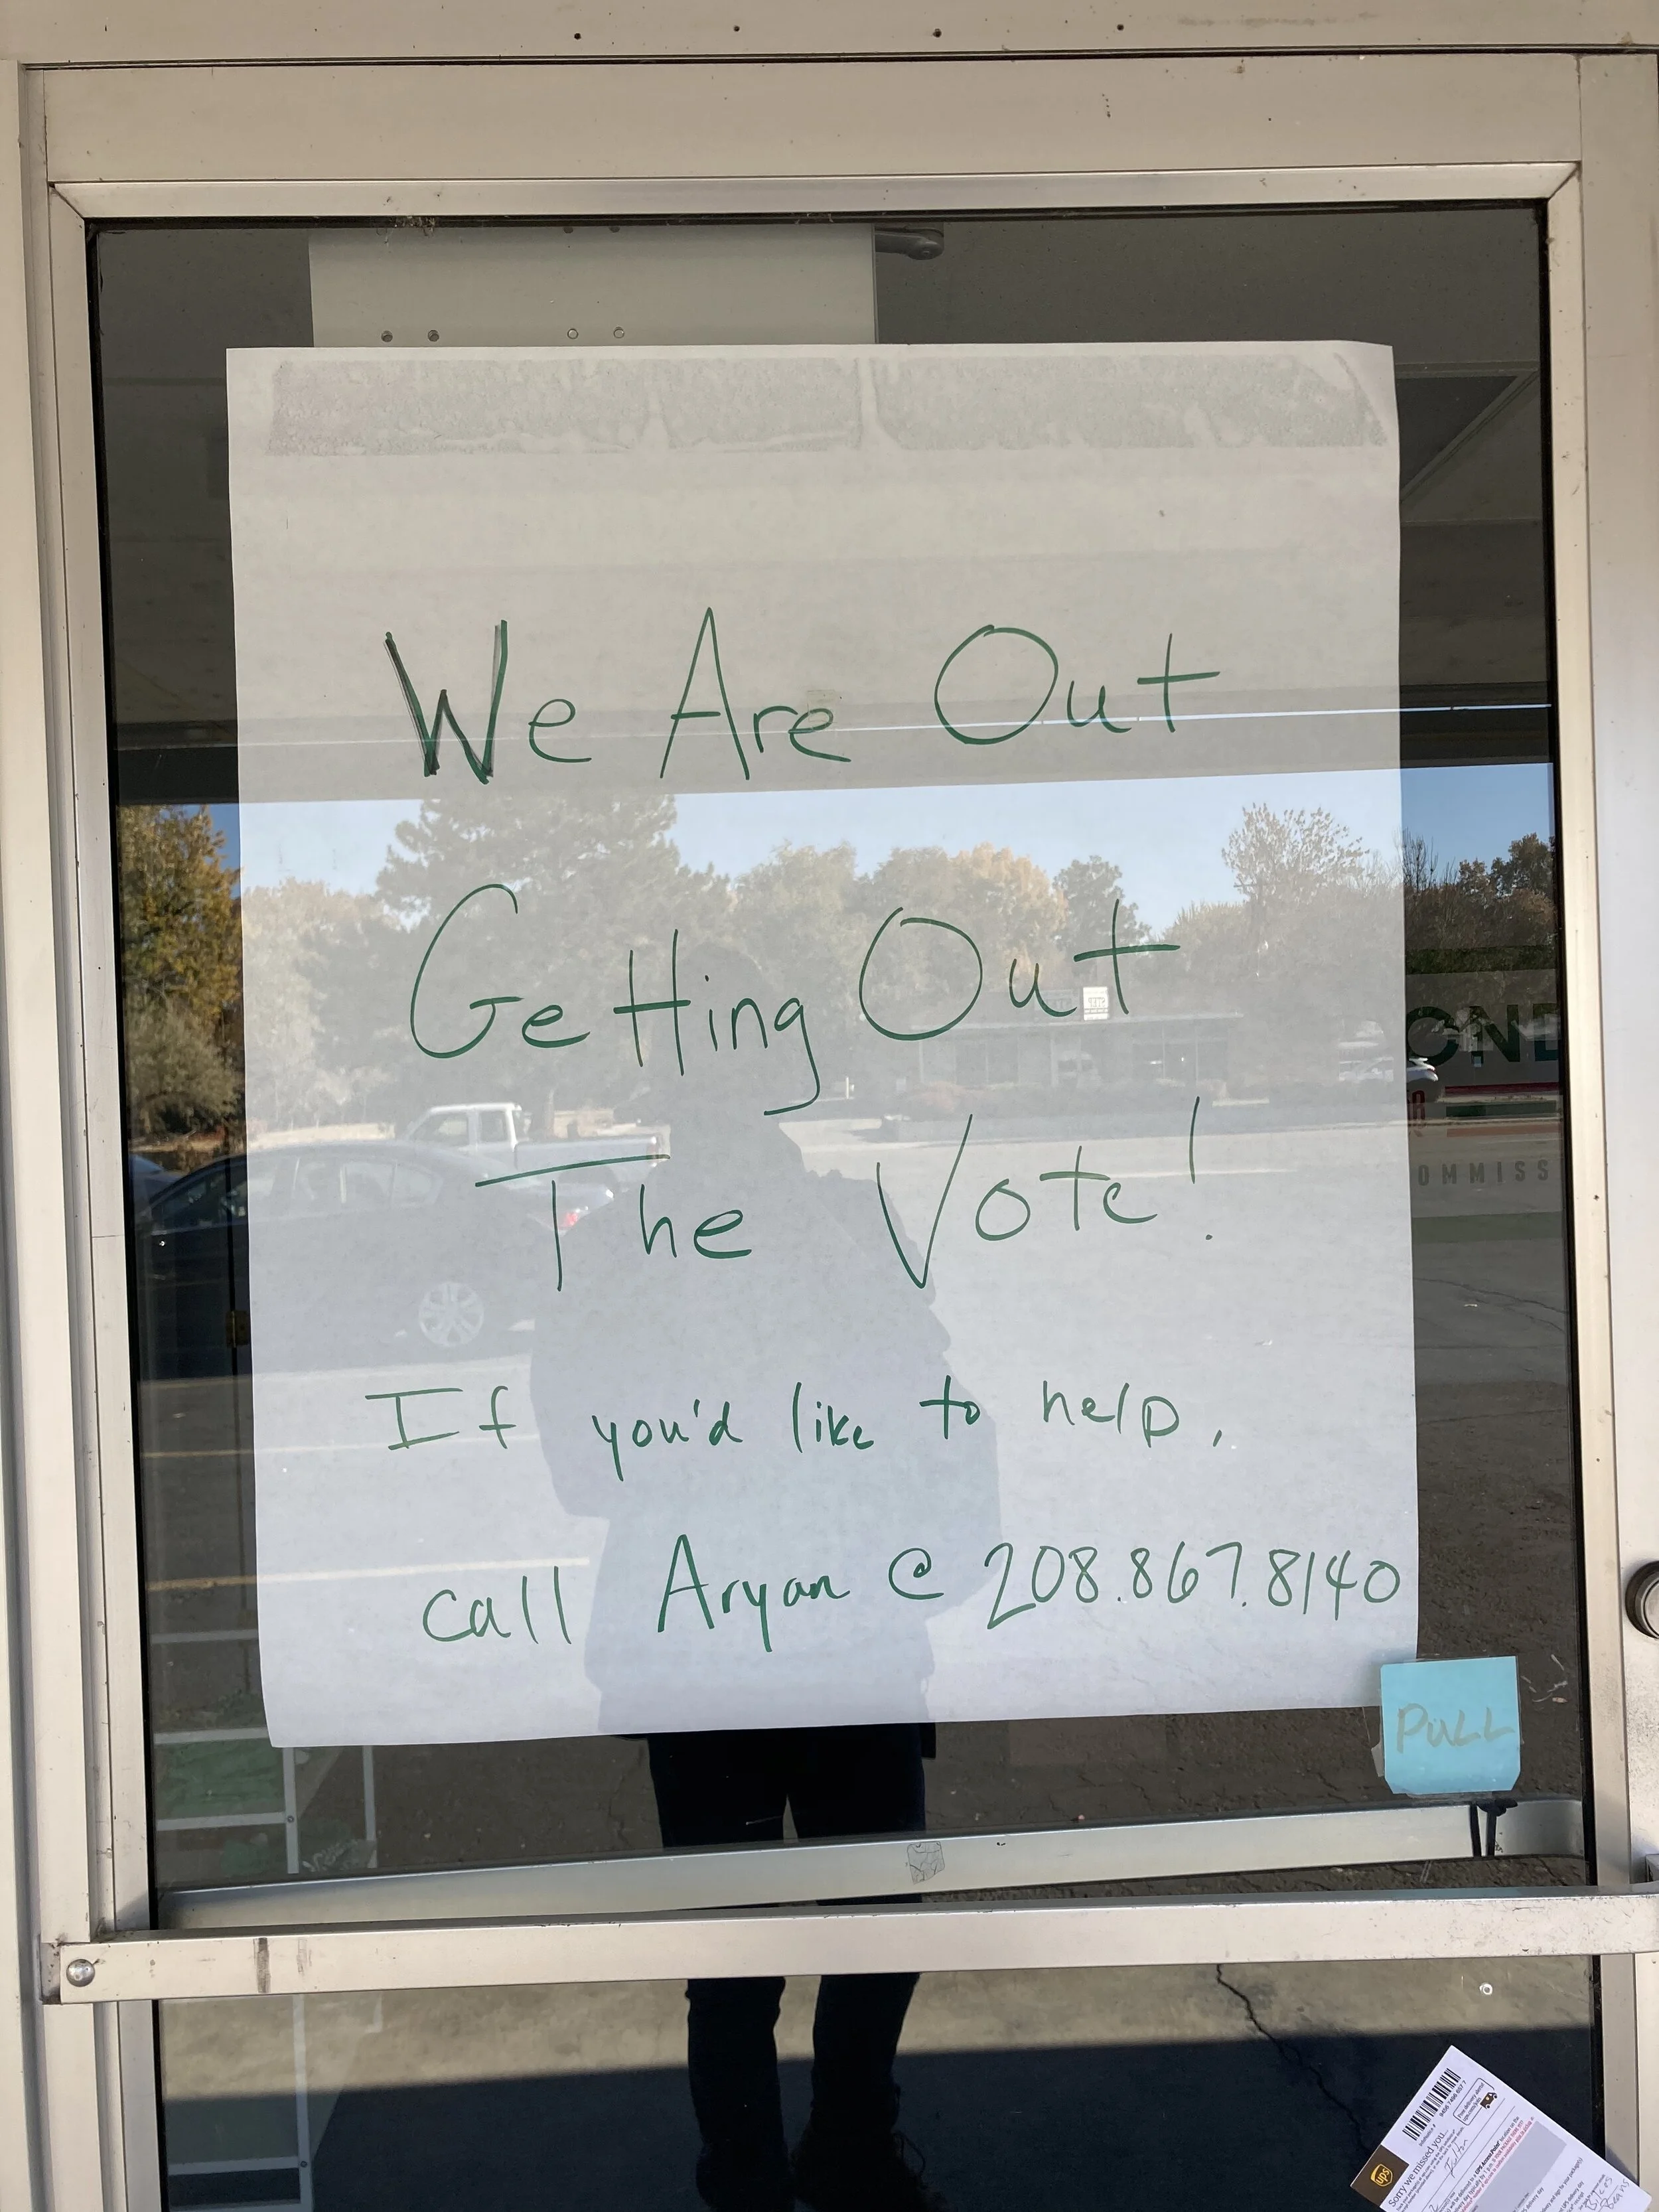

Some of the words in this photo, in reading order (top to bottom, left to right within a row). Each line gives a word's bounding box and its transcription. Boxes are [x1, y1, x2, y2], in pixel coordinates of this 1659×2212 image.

[386, 620, 591, 784] We
[660, 608, 851, 780] Are
[934, 625, 1219, 745] Out
[410, 884, 820, 1116] Getting
[859, 899, 1181, 1041] Out
[475, 1155, 752, 1291] The
[877, 1096, 1212, 1289] Vote!
[365, 1386, 516, 1450] If
[592, 1399, 743, 1481] you'd
[792, 1382, 874, 1453] like
[919, 1375, 980, 1439] to
[658, 1534, 850, 1653] Aryan
[984, 1541, 1400, 1629] 208.867.8140
[1457, 2108, 1466, 2118] Free
[1463, 2093, 1477, 2110] delivery
[1374, 2167, 1392, 2186] ups
[1388, 2184, 1408, 2208] Sorry
[1404, 2173, 1415, 2187] we
[1410, 2146, 1435, 2174] missed
